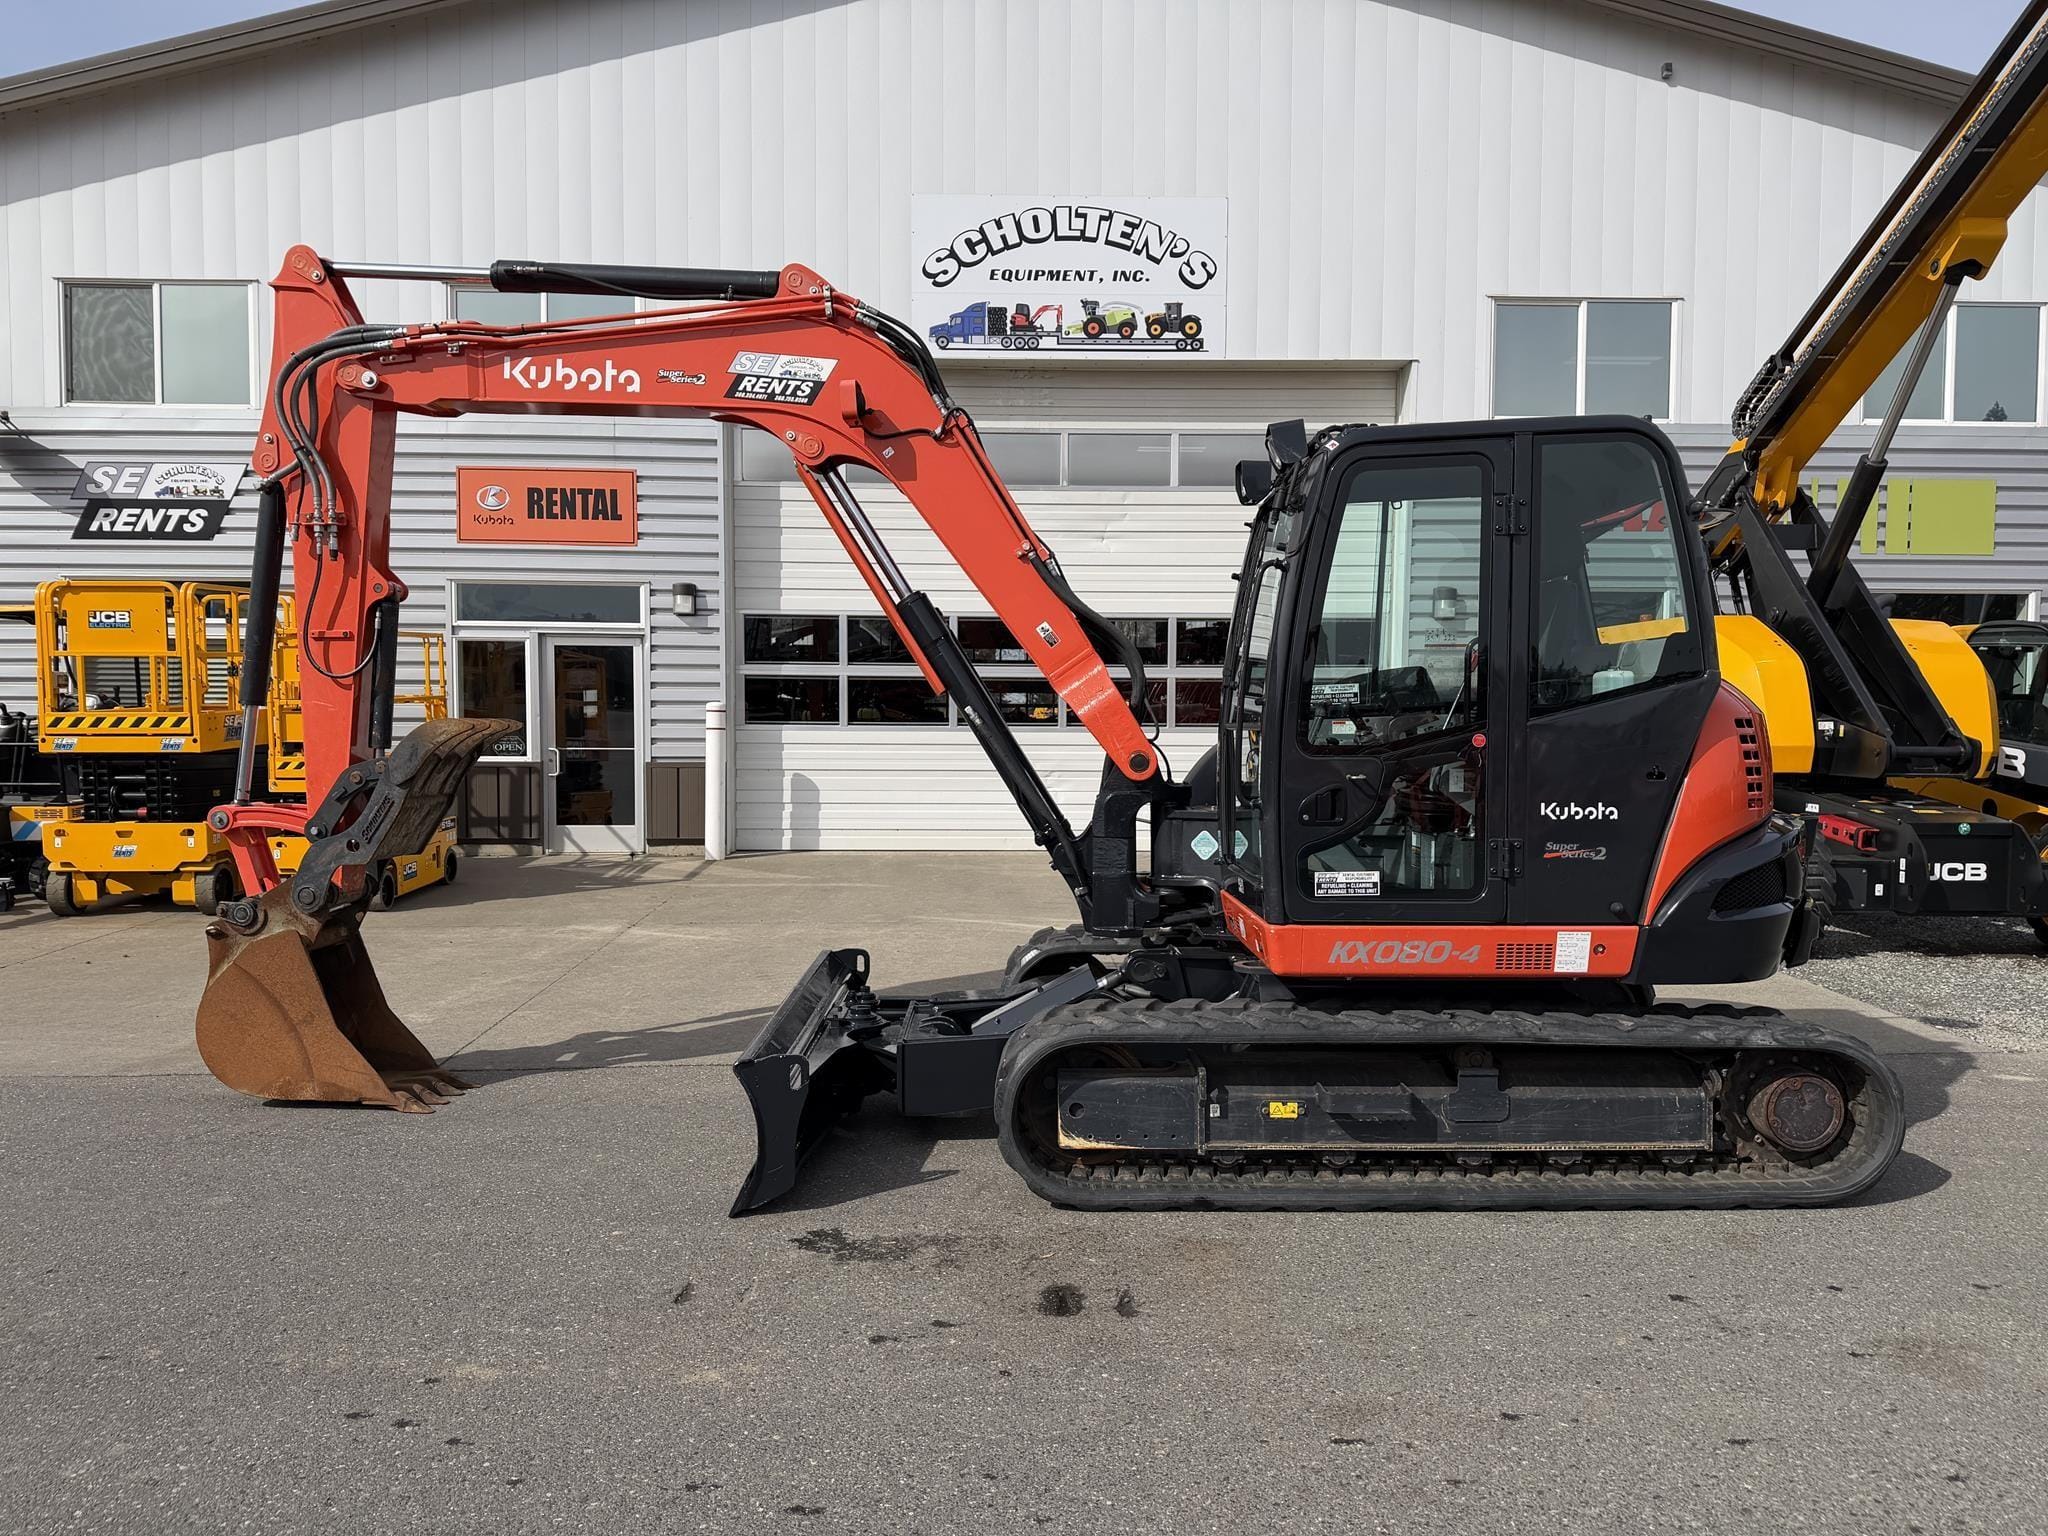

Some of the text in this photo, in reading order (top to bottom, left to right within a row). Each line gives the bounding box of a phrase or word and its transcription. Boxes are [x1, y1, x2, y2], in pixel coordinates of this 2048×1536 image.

[922, 205, 1218, 290] SCHOLTEN'S
[989, 269, 1151, 284] EQUIPMENT, INC.
[735, 353, 774, 374] SE
[503, 356, 641, 393] Kubota
[658, 369, 684, 378] Super
[670, 373, 706, 385] Series 2
[738, 376, 814, 396] RENTS
[85, 466, 147, 494] SE
[154, 464, 226, 486] SCHOLTEN'S
[526, 487, 622, 521] RENTAL
[88, 508, 209, 533] RENTS
[473, 514, 514, 525] Kubota
[89, 611, 130, 623] JCB
[224, 715, 235, 727] SE
[494, 743, 523, 751] OPEN
[1540, 802, 1618, 820] Kubota
[1545, 841, 1579, 851] Super
[1561, 846, 1607, 860] Series 2
[1929, 862, 1987, 881] JCB
[1328, 940, 1482, 964] KX080-4
